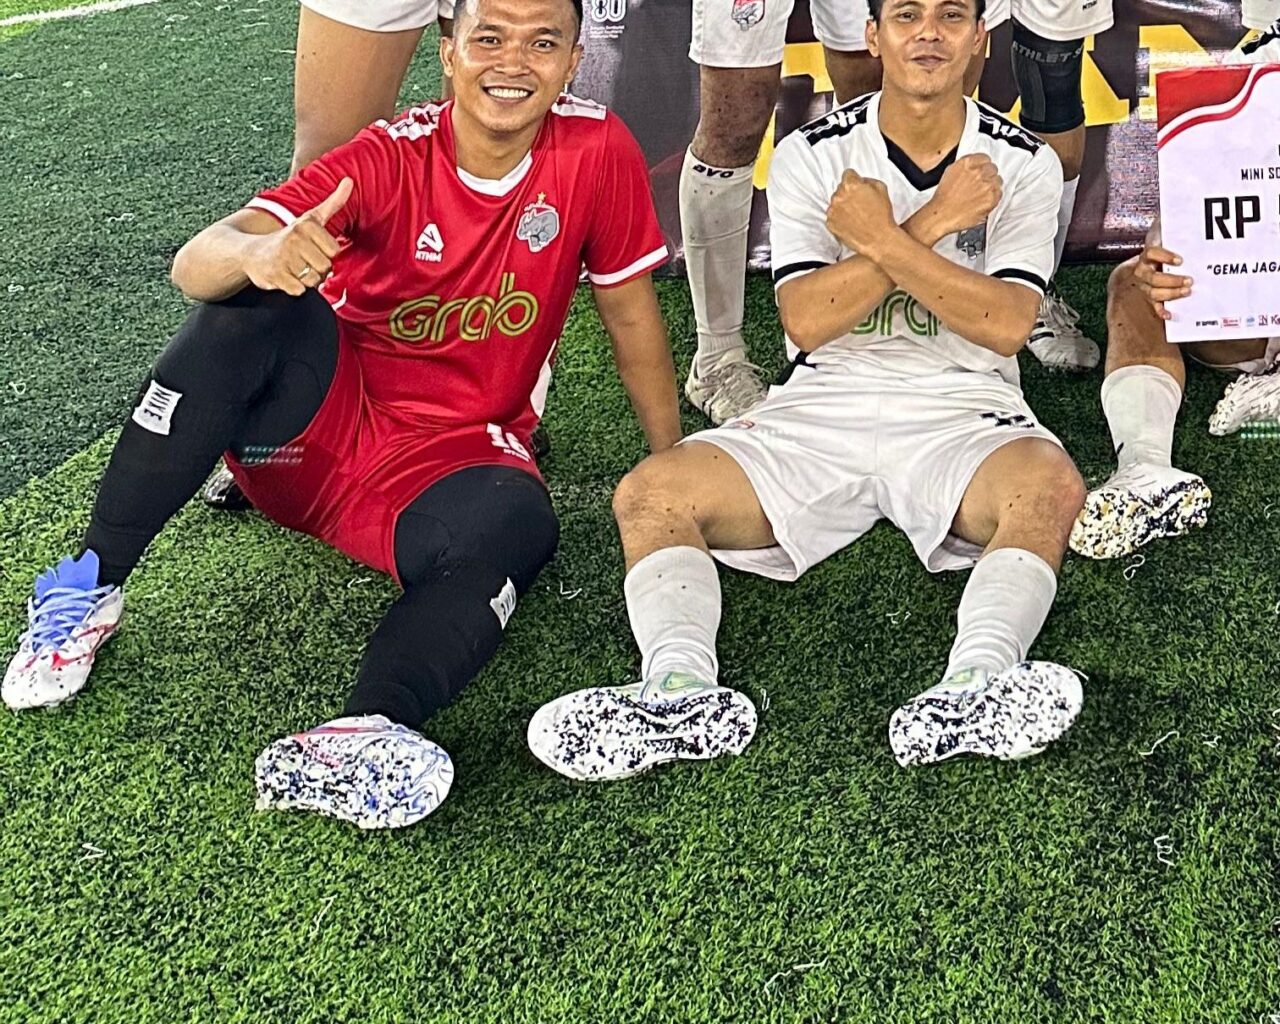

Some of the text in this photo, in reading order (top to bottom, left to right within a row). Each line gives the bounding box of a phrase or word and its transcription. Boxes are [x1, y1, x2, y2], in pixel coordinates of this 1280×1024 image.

[1241, 167, 1264, 181] MINI
[1204, 196, 1262, 240] RP
[390, 272, 538, 341] Grab
[143, 386, 172, 422] NIKE
